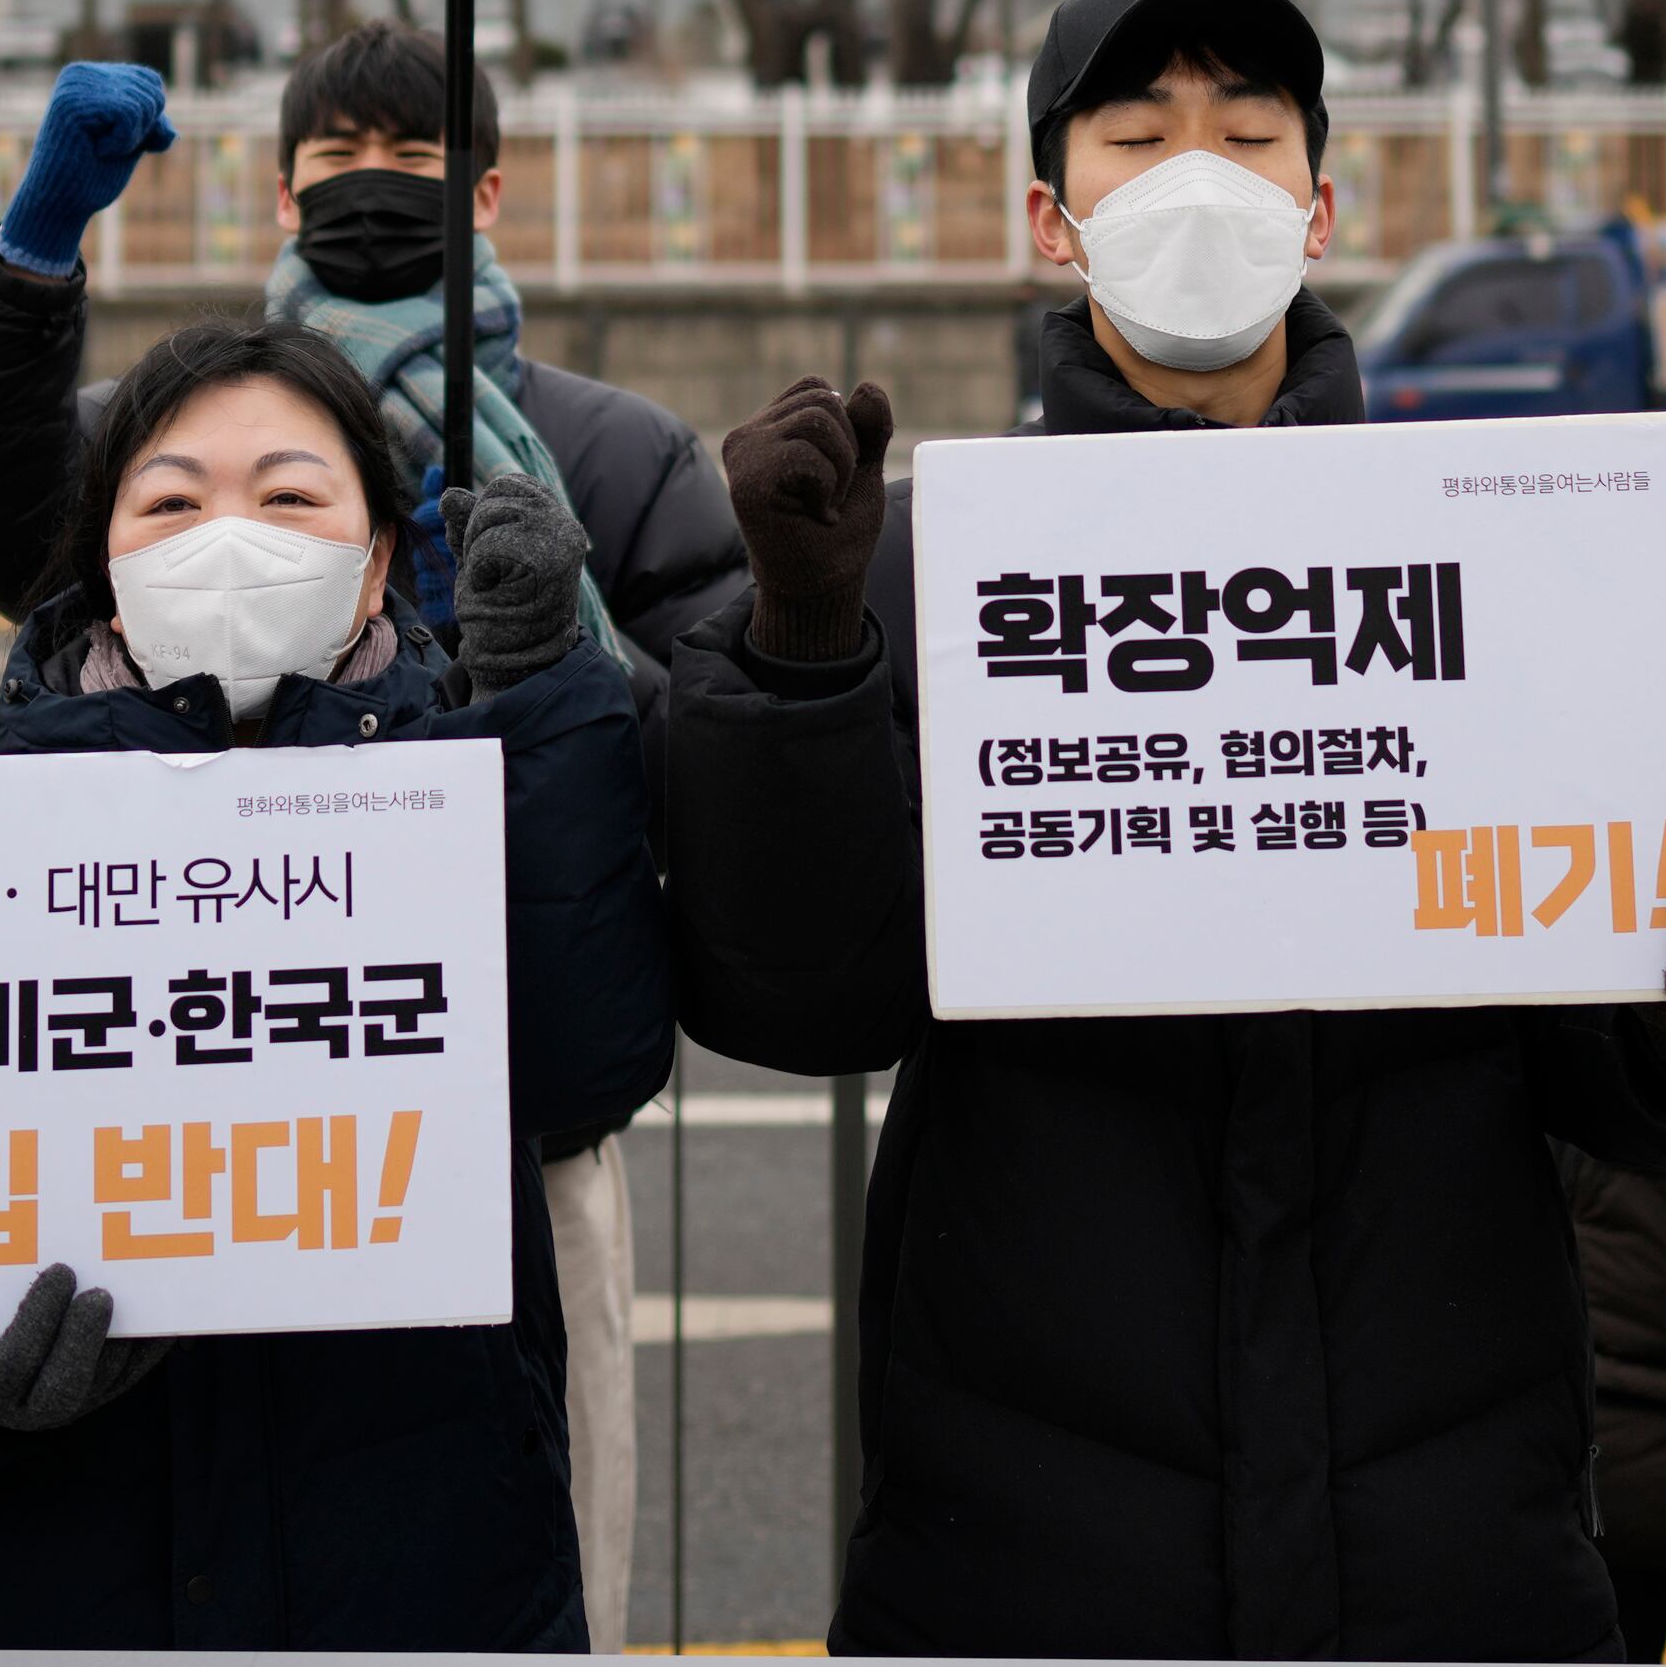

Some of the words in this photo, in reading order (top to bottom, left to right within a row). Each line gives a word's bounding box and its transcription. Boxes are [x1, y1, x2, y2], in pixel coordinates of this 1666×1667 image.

[1442, 471, 1650, 497] 평화와통일을여는사람들
[977, 562, 1465, 693] 확장억제
[979, 734, 1203, 786] (정보공유,
[1221, 726, 1427, 778] 협의절차,
[237, 790, 445, 817] 평화와통일을여는사람들
[980, 806, 1171, 859] 공동기획
[1189, 805, 1236, 853] 및
[1250, 801, 1347, 850] 실행
[48, 860, 166, 928] 대만
[176, 852, 352, 923] 유사시
[94, 1110, 422, 1261] 반대!
